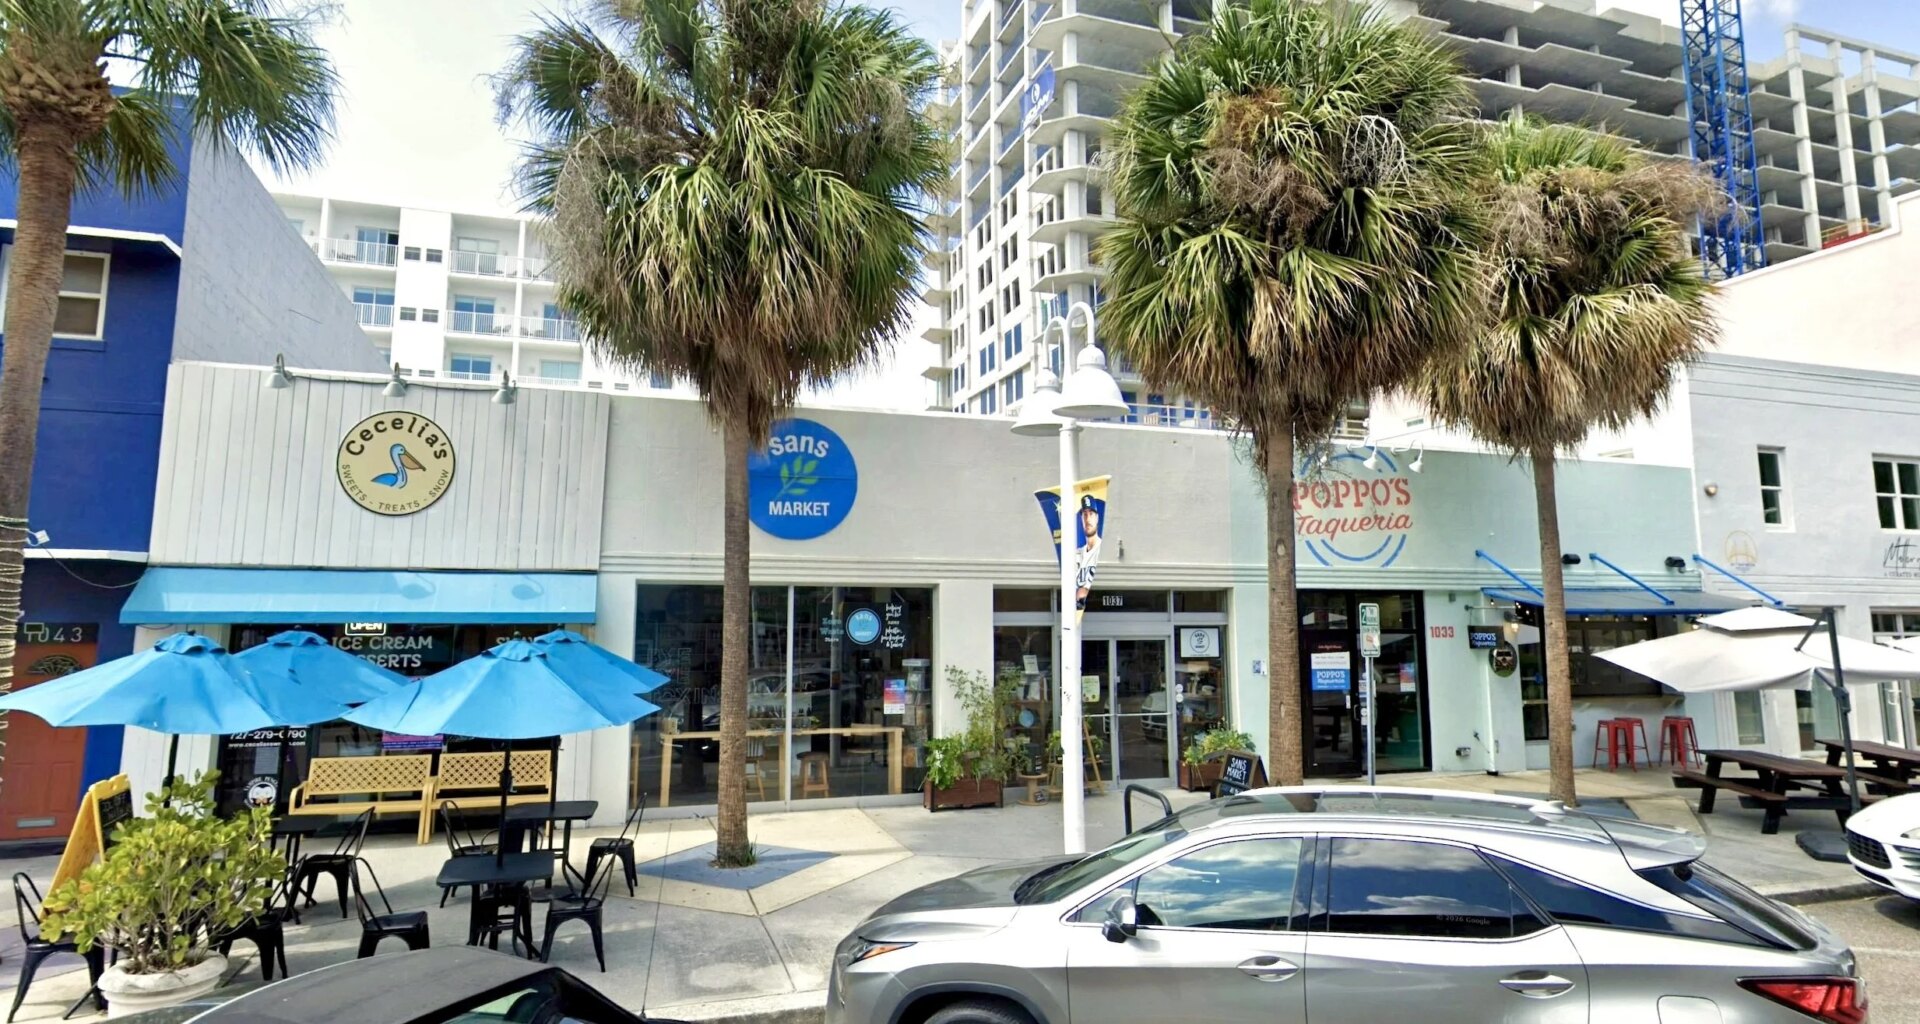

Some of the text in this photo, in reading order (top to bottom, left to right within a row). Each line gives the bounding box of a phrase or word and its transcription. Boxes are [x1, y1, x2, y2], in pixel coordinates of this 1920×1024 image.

[345, 416, 448, 460] Cecelia's
[768, 434, 830, 458] sans
[341, 463, 368, 502] SWEETS
[378, 500, 421, 512] TREATS
[428, 468, 449, 499] SNOW
[1292, 478, 1412, 511] POPPO'S
[768, 500, 830, 517] MARKET
[1295, 511, 1414, 543] Taqueria
[1102, 595, 1124, 606] 1037
[1361, 608, 1367, 624] 2
[349, 622, 383, 631] OPEN
[1430, 626, 1455, 638] 1033
[331, 635, 433, 650] ICE CREAM
[1231, 757, 1248, 771] SANS
[1227, 766, 1248, 785] MARKET
